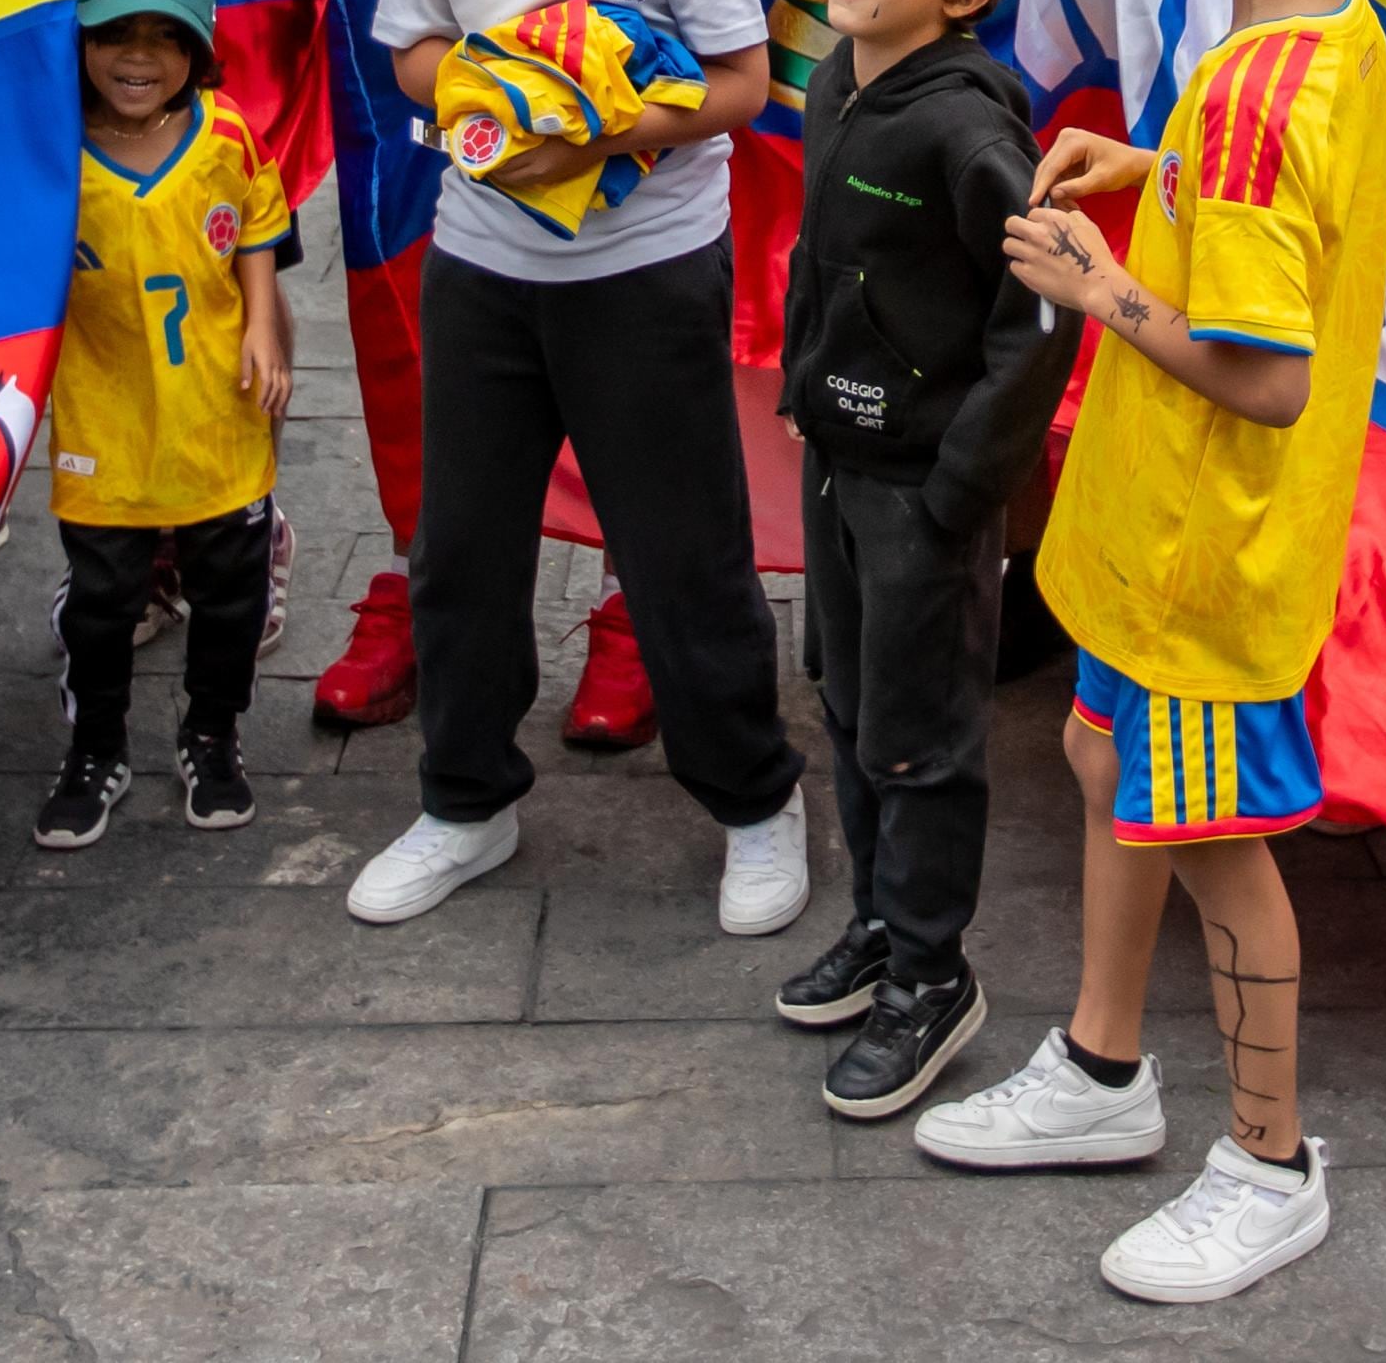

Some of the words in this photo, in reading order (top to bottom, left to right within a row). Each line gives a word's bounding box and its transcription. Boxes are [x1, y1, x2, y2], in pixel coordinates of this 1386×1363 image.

[846, 175, 893, 200] Alejandro
[895, 192, 923, 206] Zaga
[143, 274, 190, 366] 7
[826, 374, 885, 400] COLEGIO
[838, 397, 883, 417] OLAMI
